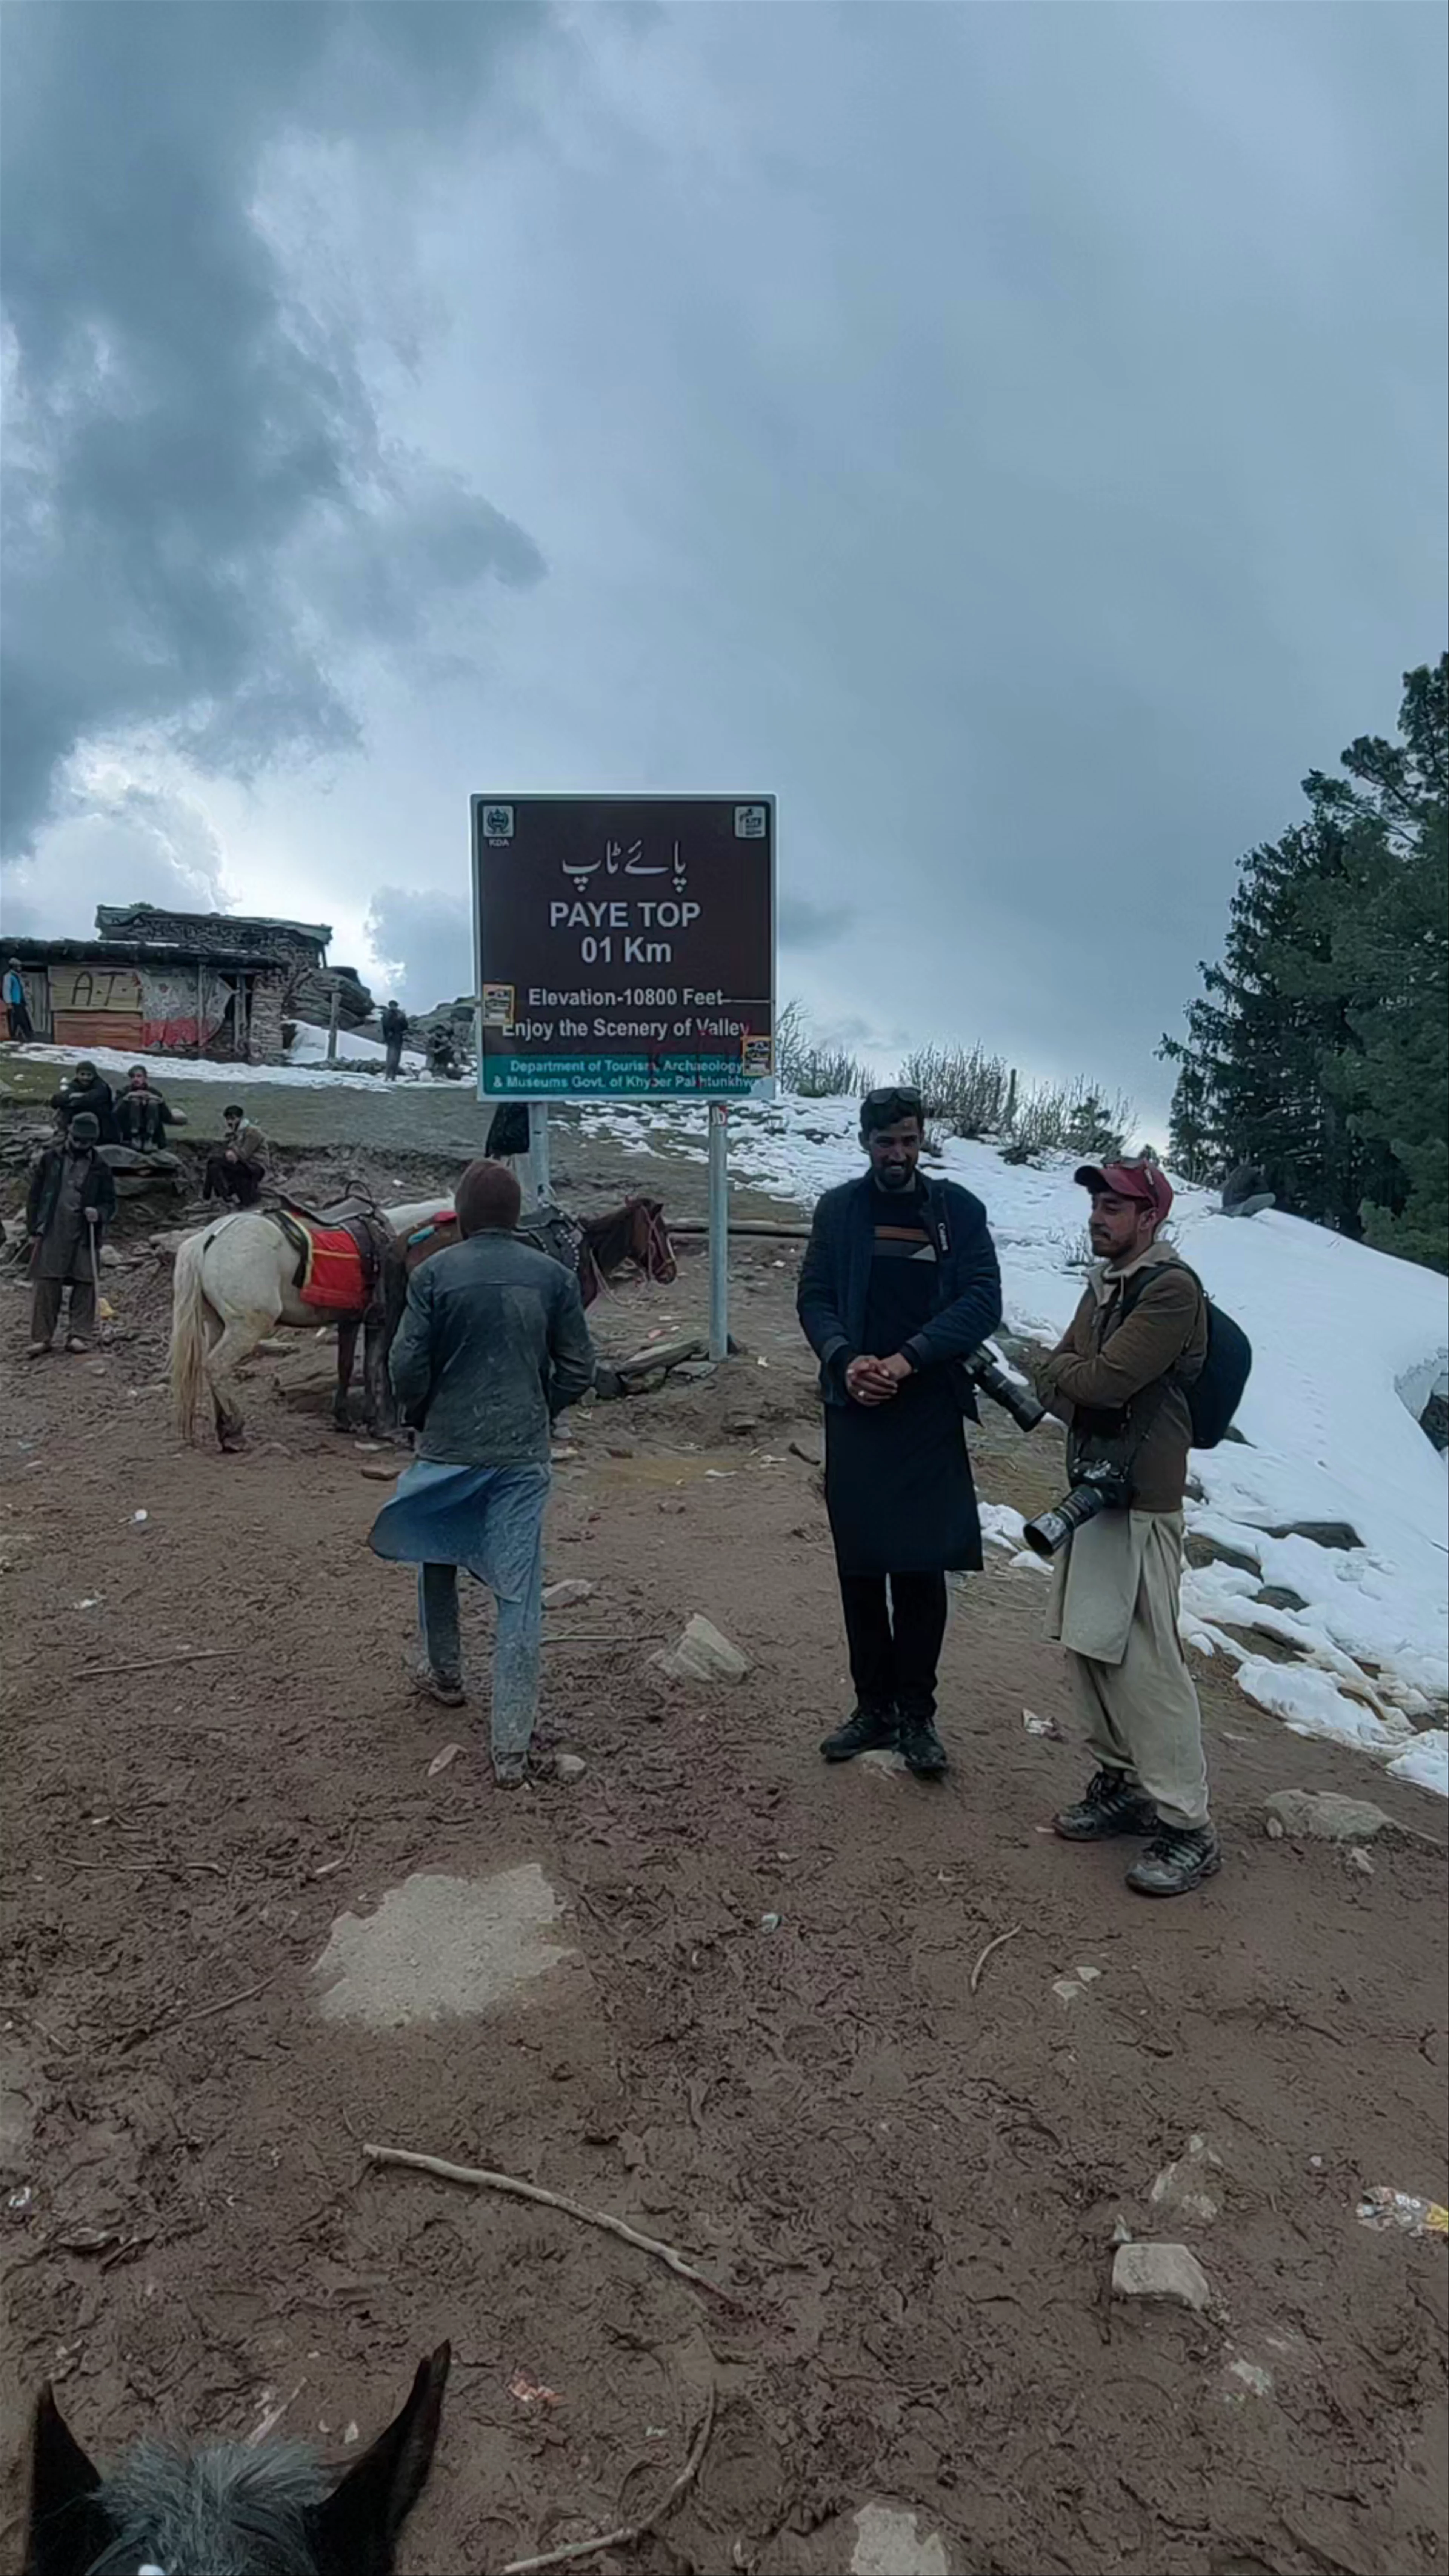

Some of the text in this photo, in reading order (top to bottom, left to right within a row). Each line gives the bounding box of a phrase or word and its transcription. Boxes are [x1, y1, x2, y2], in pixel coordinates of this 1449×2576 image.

[550, 901, 701, 927] PAYE TOP
[581, 936, 671, 963] 01 Km
[529, 988, 677, 1006] Elevation-10800
[683, 988, 723, 1006] Feet
[559, 1018, 588, 1036] the
[593, 1018, 668, 1041] Scenery
[673, 1018, 692, 1036] of
[696, 1018, 751, 1036] Valley
[510, 1060, 585, 1074] Department
[588, 1060, 601, 1072] of
[493, 1075, 503, 1088] &
[506, 1075, 568, 1088] Museums
[571, 1075, 606, 1088] Govt.
[609, 1075, 622, 1088] of
